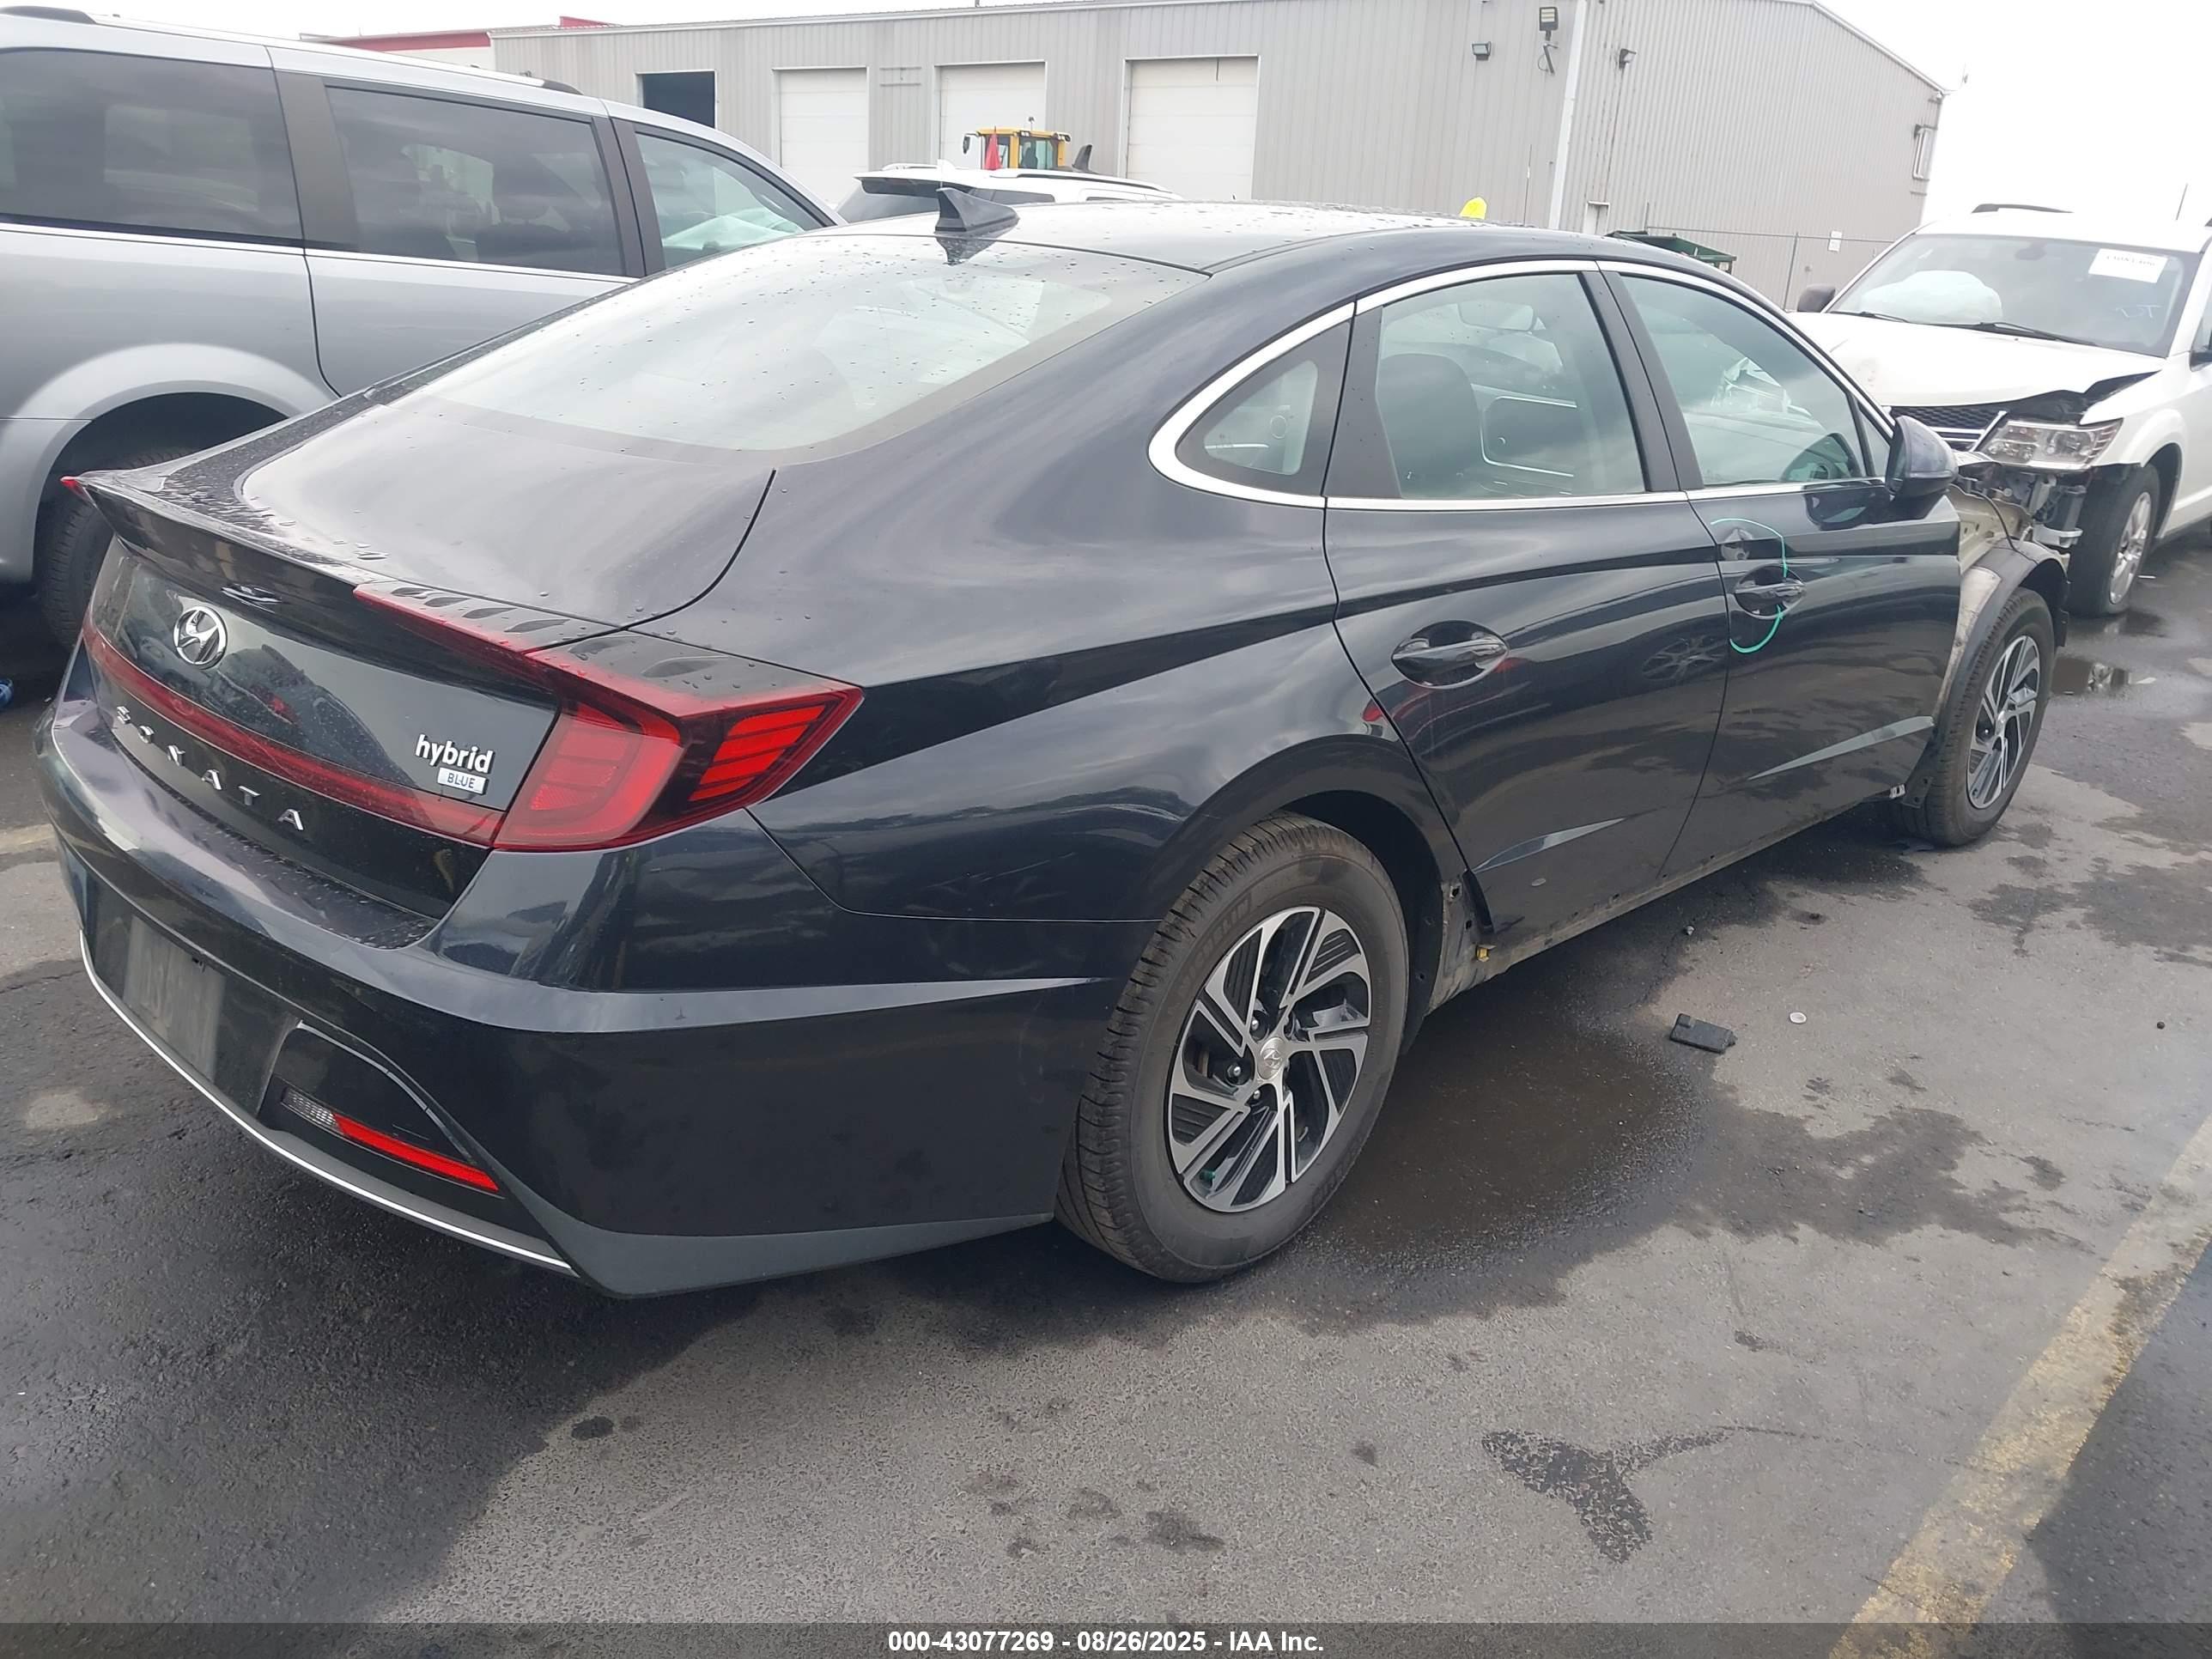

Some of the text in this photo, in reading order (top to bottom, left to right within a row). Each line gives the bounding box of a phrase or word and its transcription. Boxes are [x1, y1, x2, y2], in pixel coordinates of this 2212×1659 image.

[117, 706, 304, 831] SONATA
[416, 733, 495, 774] hybrid
[447, 773, 476, 789] BLUE
